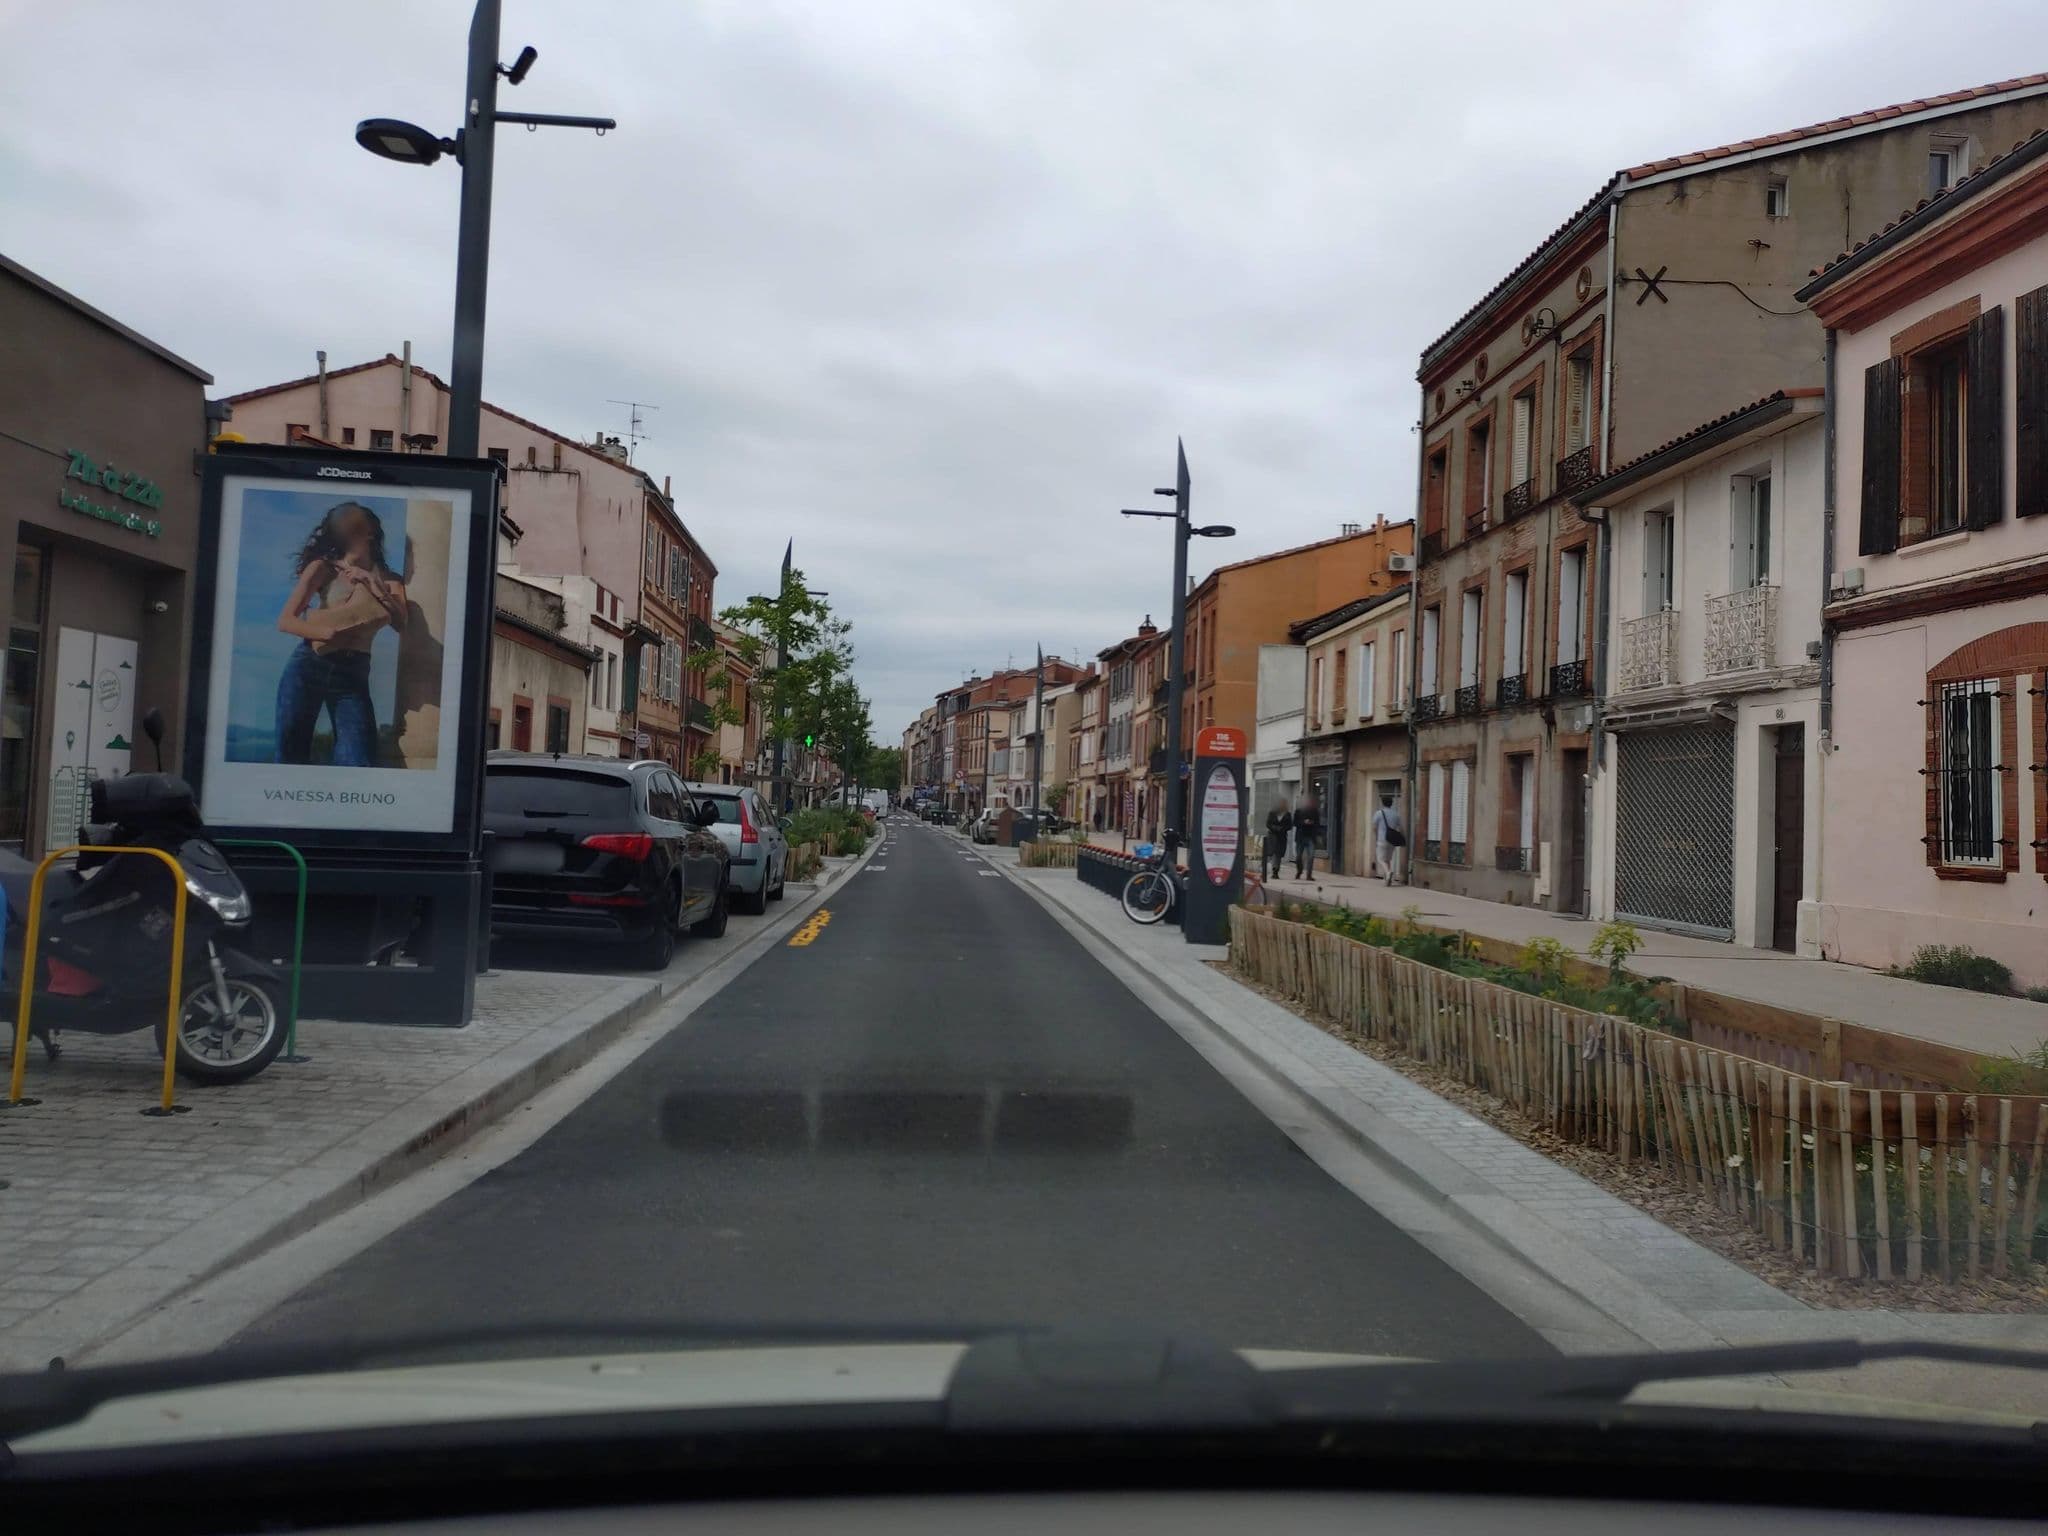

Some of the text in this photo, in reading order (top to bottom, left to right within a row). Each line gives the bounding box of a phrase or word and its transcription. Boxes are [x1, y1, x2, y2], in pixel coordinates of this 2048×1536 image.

[317, 467, 372, 480] JCDecaux
[264, 788, 396, 806] VANESSA BRUNO
